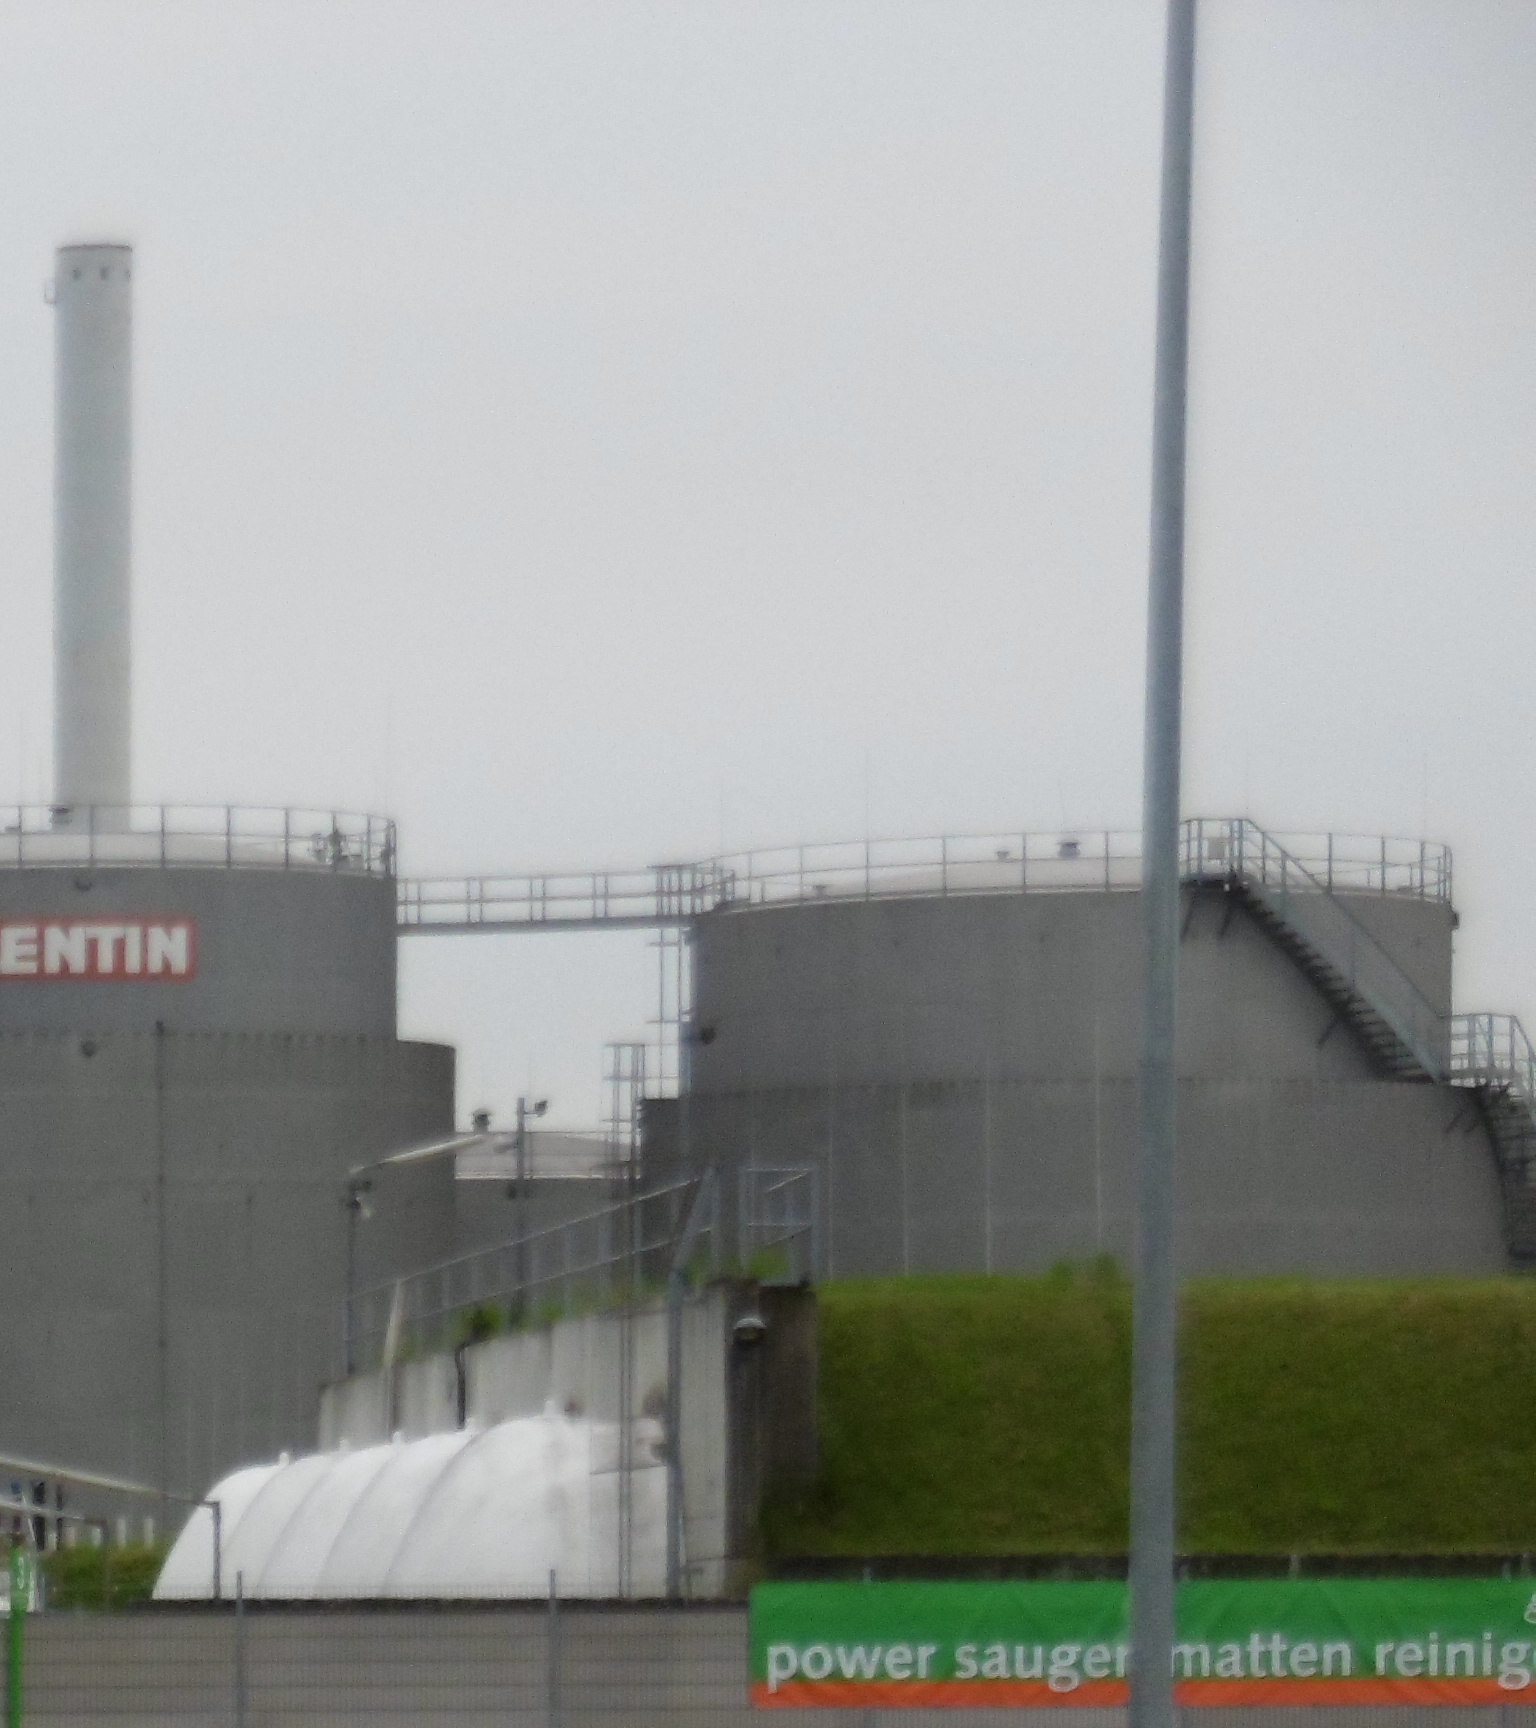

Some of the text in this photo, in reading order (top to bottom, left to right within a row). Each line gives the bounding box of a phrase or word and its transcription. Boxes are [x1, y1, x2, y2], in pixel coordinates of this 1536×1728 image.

[766, 1631, 1536, 1692] power sauger matten reinig
